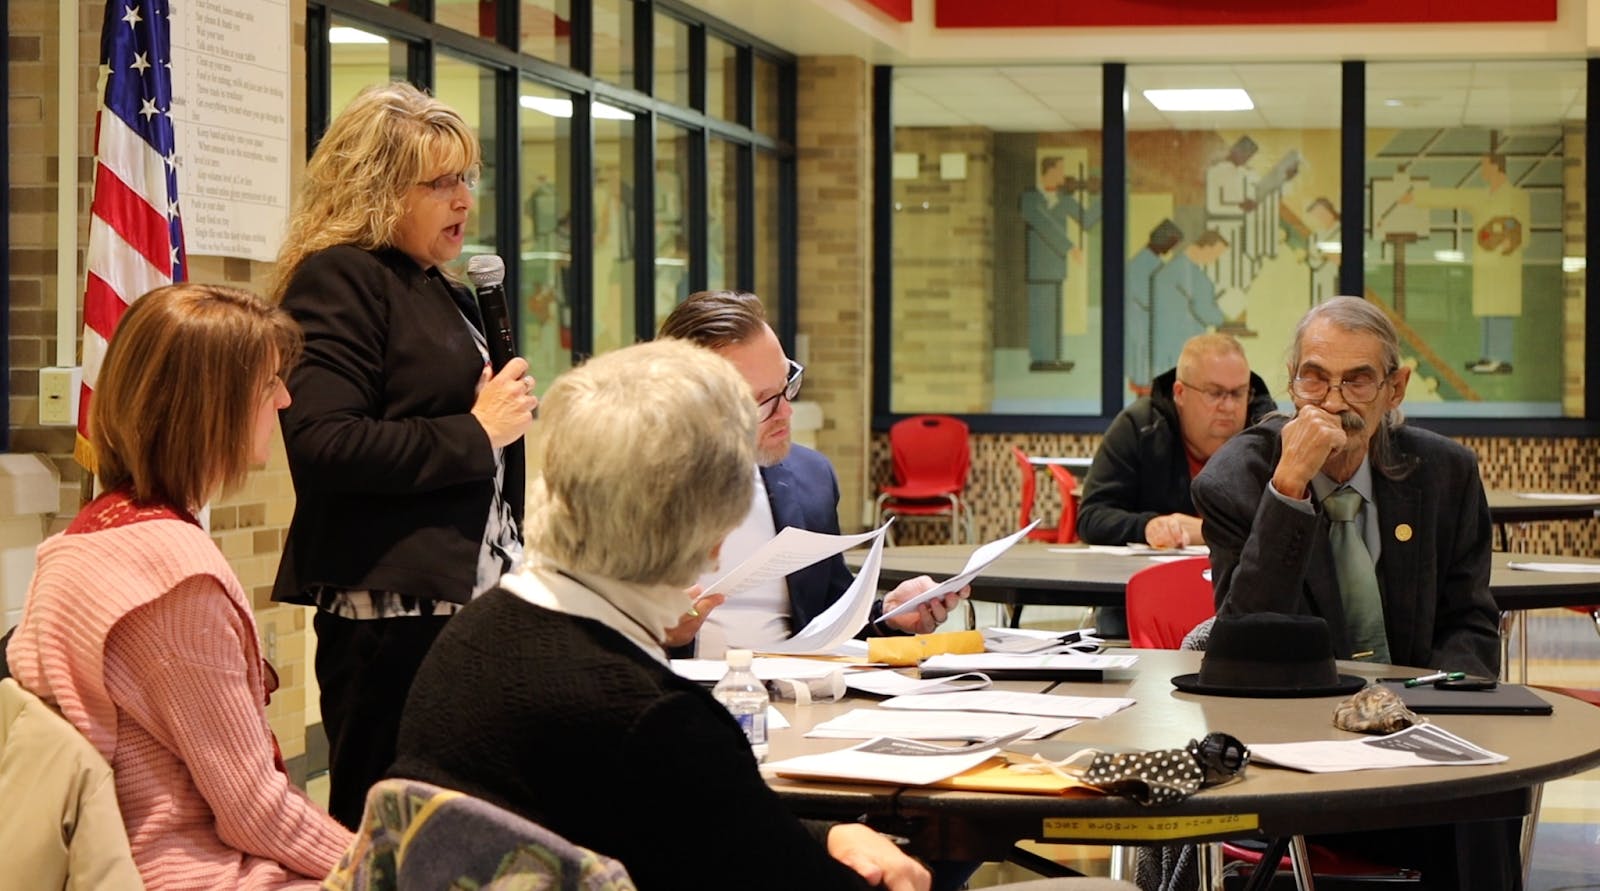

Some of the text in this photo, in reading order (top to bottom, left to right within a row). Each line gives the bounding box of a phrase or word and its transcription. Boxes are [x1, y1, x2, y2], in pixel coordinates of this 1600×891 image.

[1045, 815, 1241, 831] PUSH SLOWLY FROM THIS END
